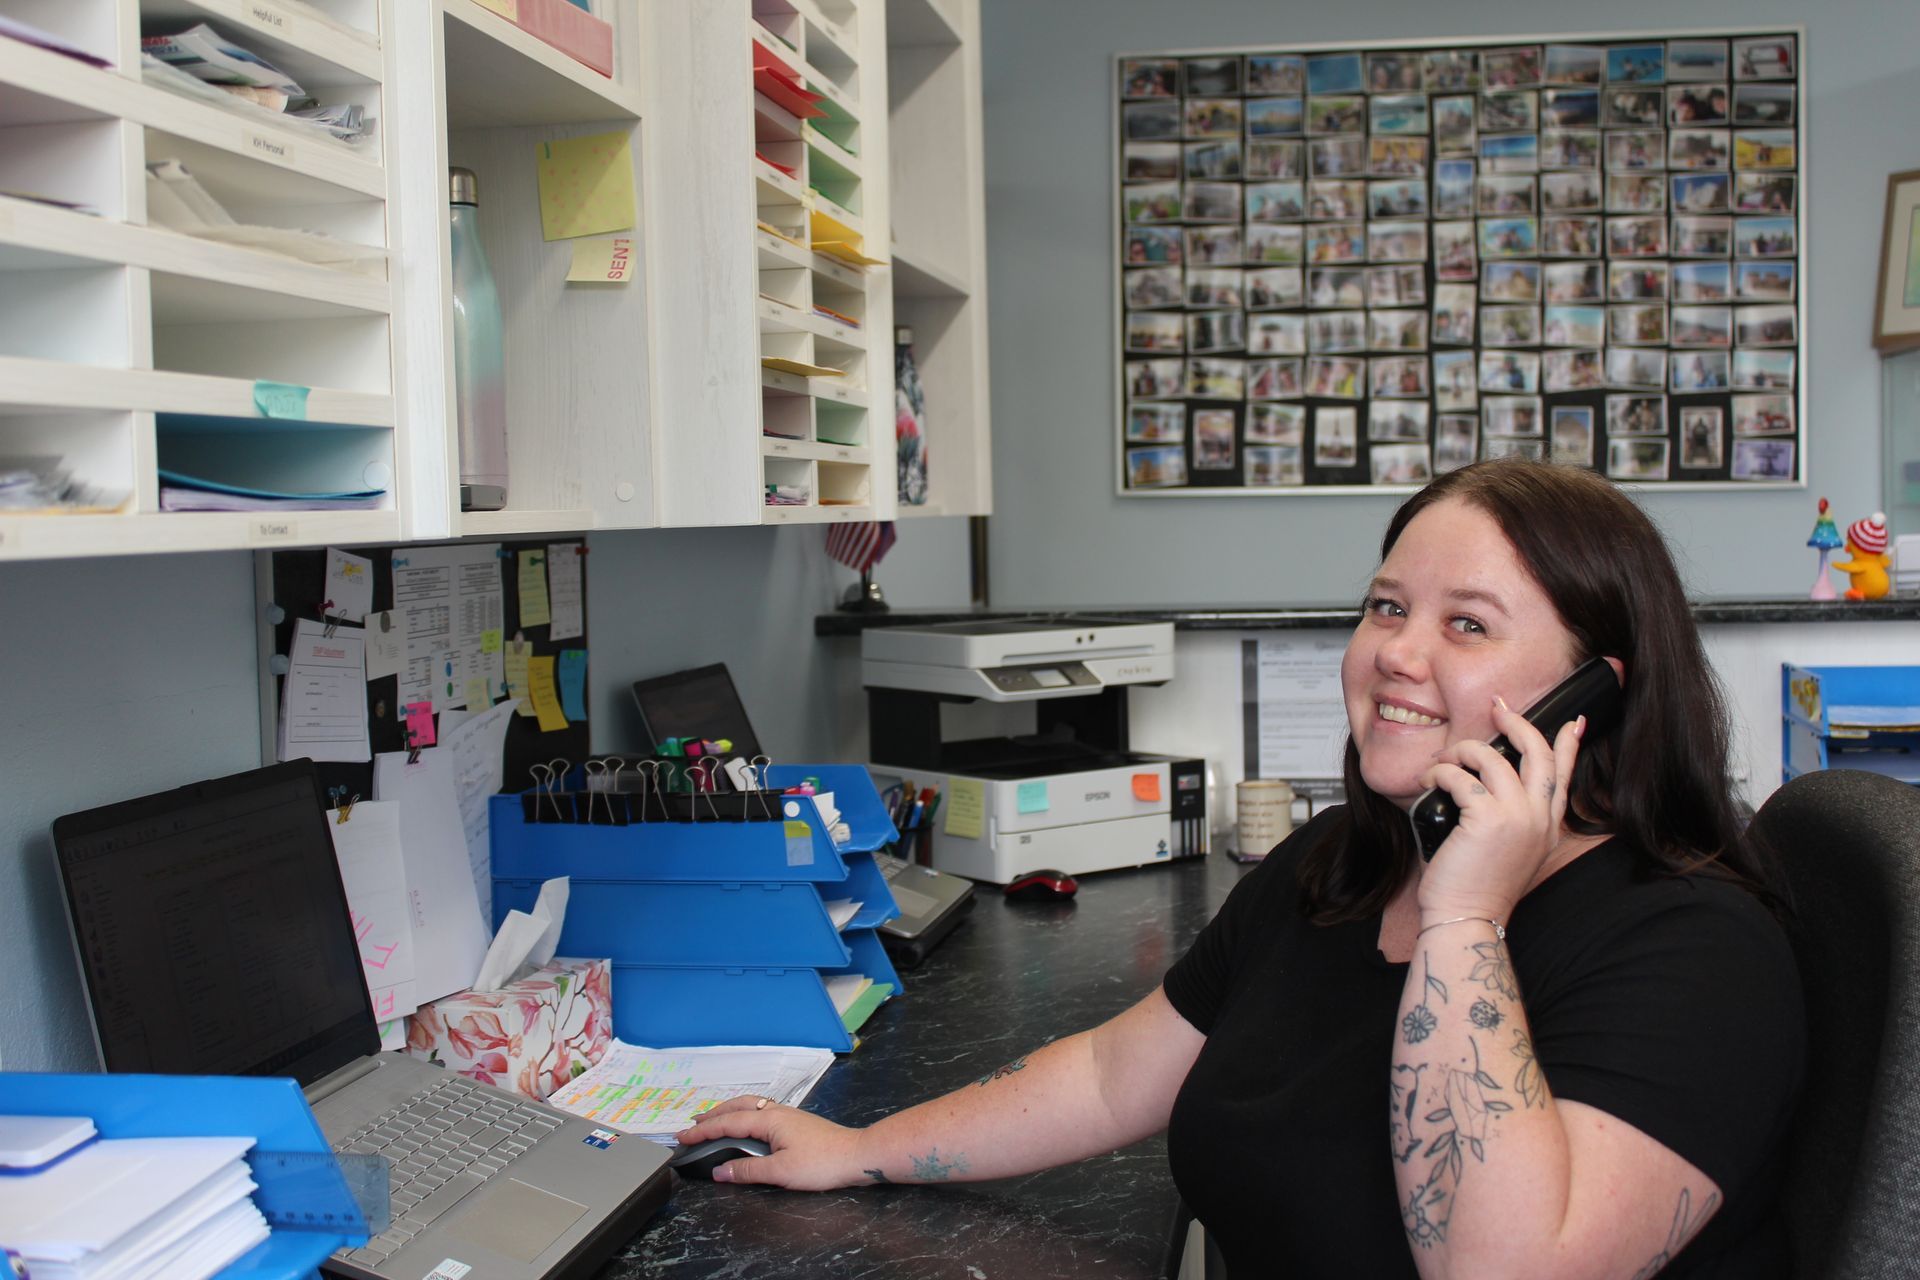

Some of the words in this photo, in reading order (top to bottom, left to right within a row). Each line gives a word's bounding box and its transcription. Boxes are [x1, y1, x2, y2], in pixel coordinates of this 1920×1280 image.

[253, 7, 272, 23] Helpful
[273, 15, 282, 27] List
[263, 141, 284, 156] Personal
[607, 239, 630, 280] SENT
[261, 525, 267, 536] To
[268, 524, 287, 536] Contact
[1084, 791, 1111, 802] EPSON
